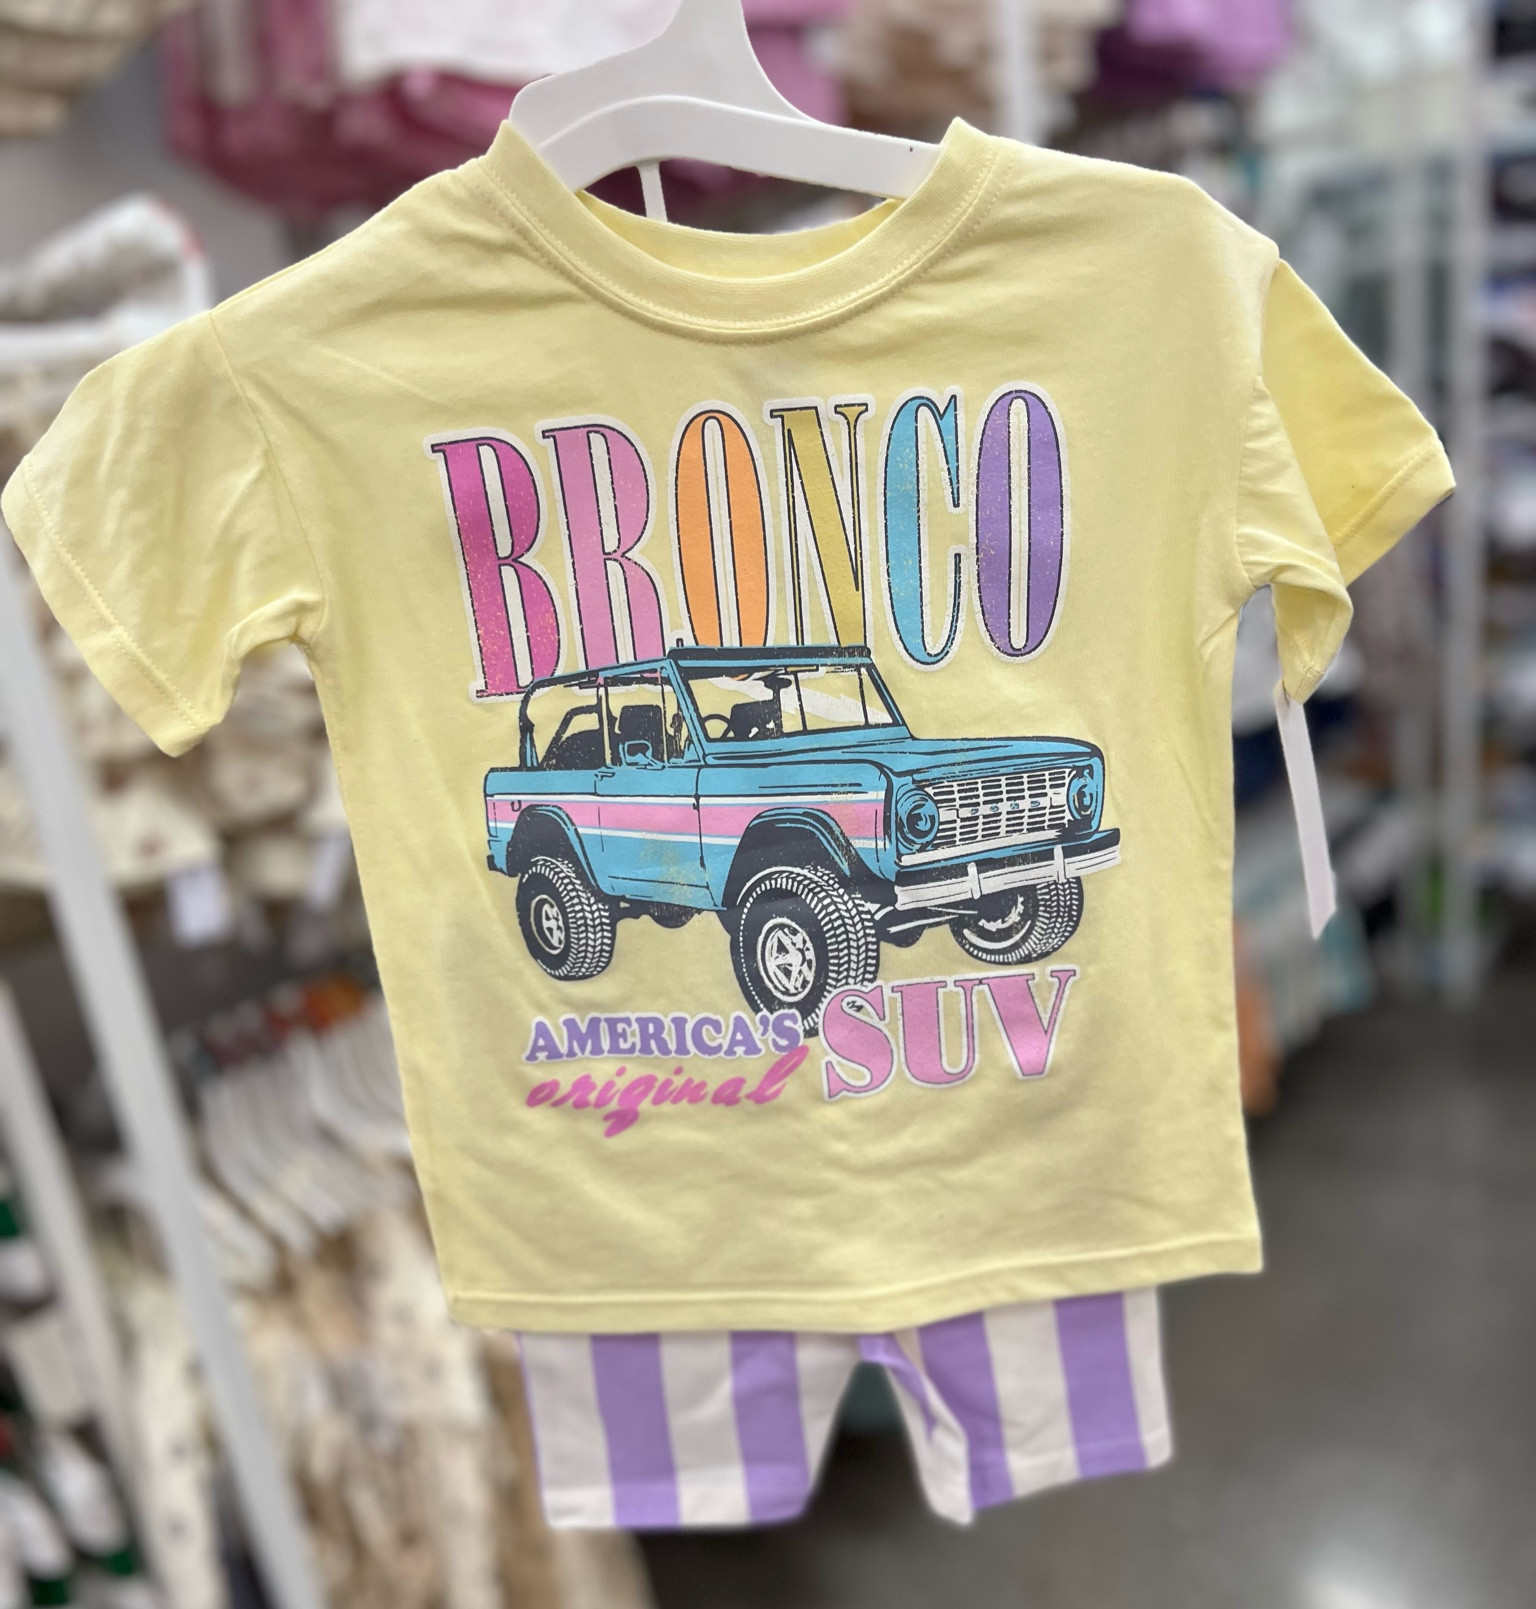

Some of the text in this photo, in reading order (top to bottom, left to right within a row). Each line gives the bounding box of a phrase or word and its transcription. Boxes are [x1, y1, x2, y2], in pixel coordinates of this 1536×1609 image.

[431, 389, 1064, 698] BRONCO
[525, 1014, 801, 1060] AMERICA'S
[825, 968, 1077, 1098] SUV
[525, 1045, 810, 1138] original
